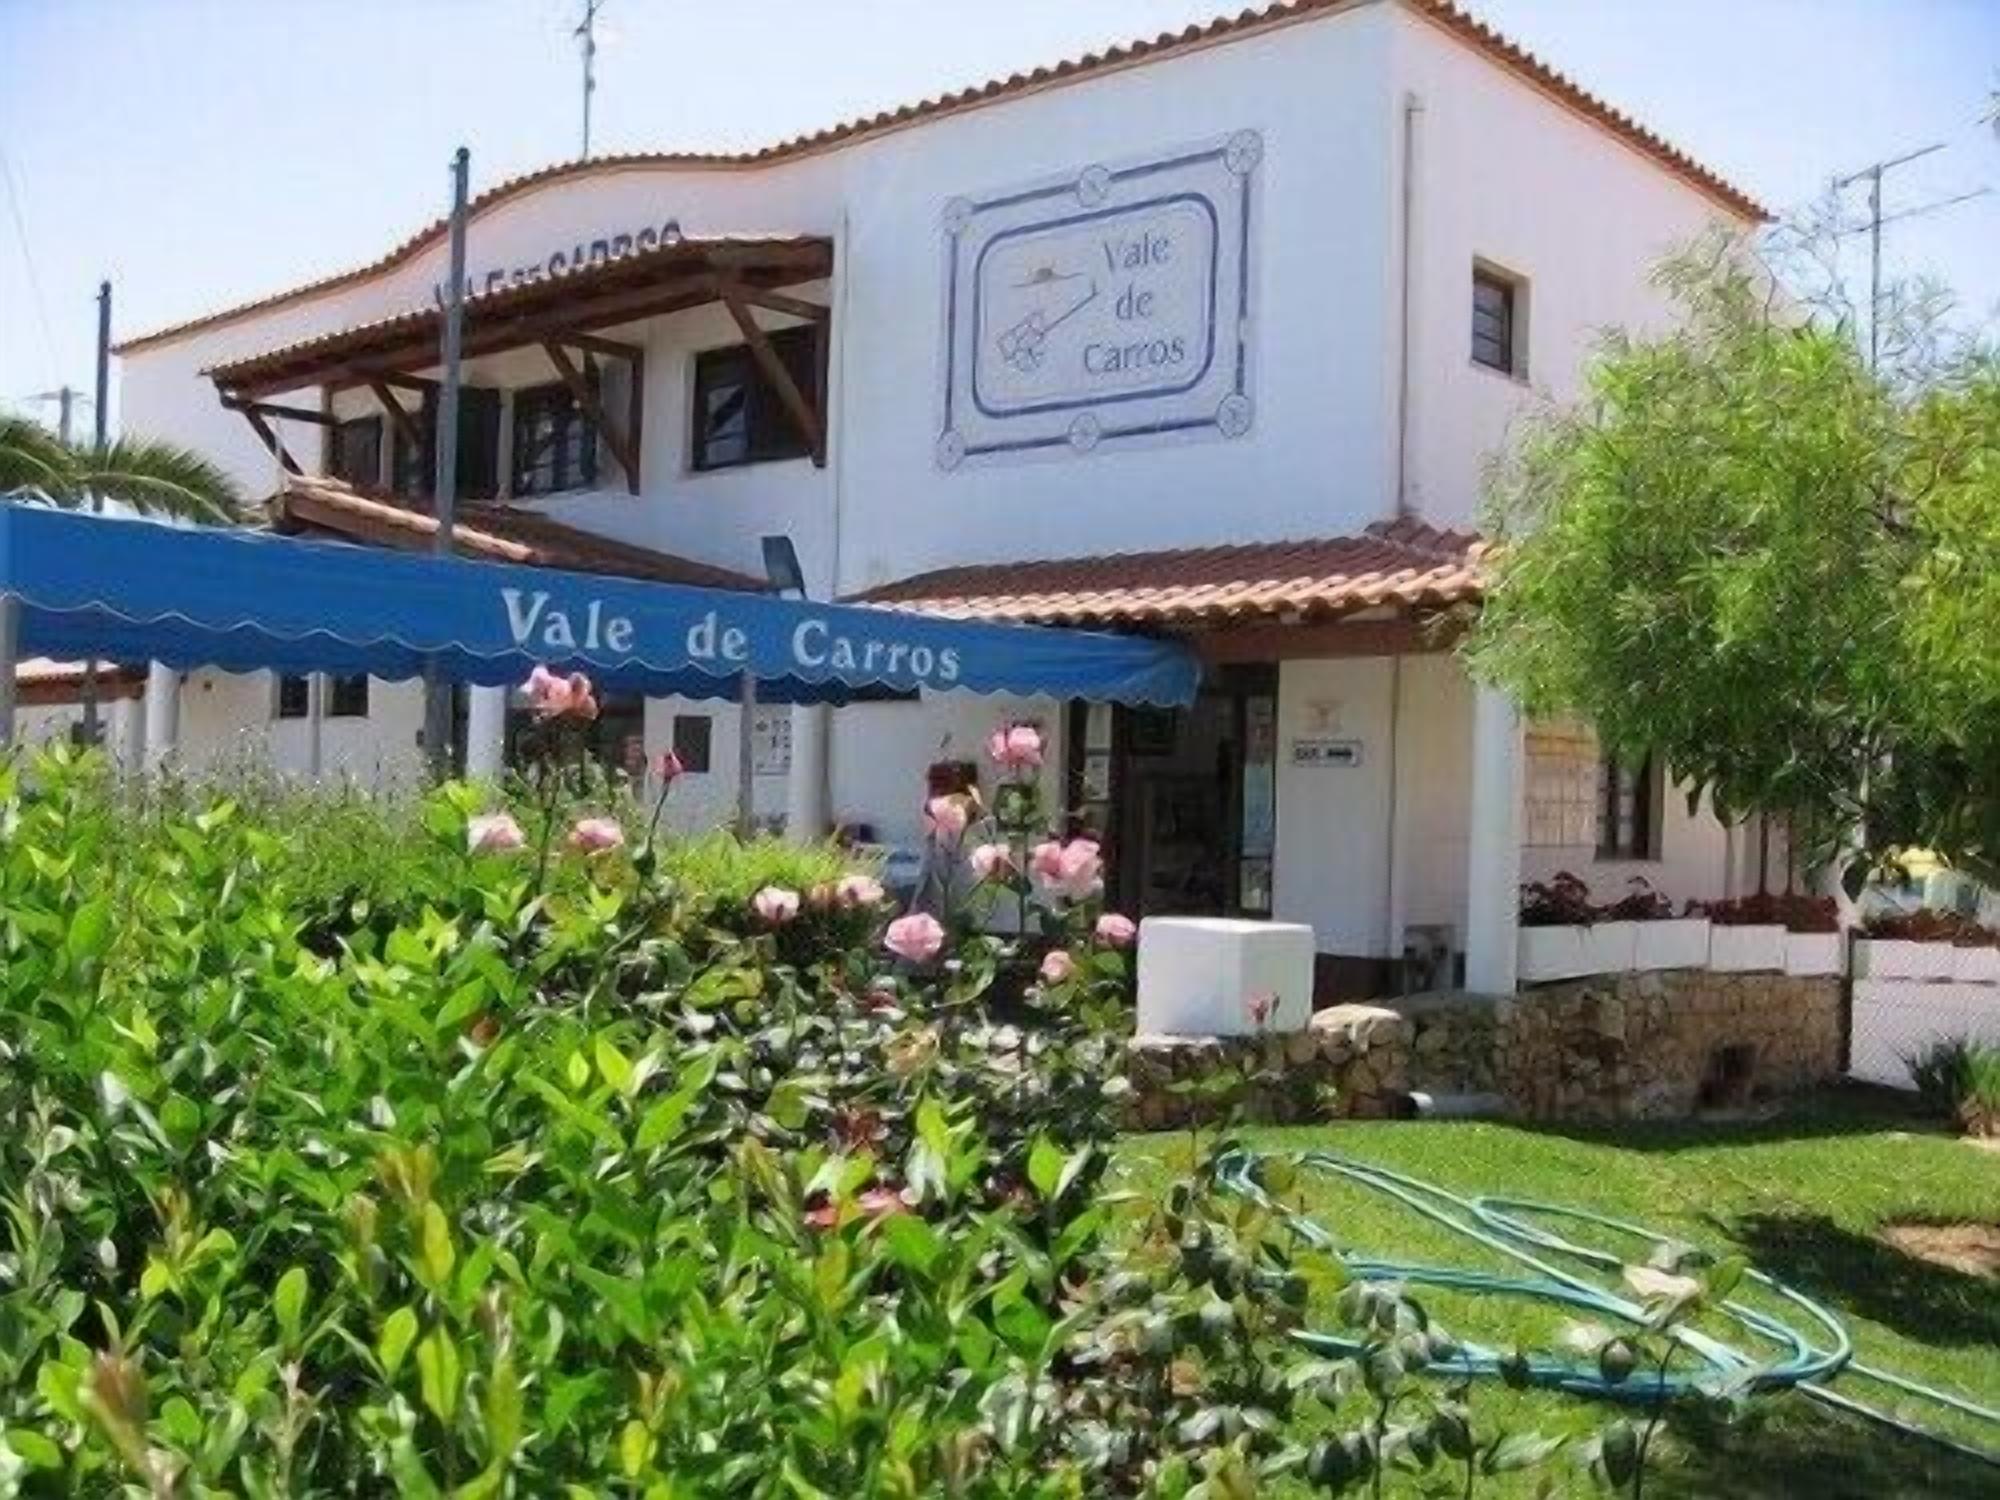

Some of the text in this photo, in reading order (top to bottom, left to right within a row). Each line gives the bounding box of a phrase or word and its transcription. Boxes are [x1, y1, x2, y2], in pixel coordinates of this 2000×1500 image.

[1103, 231, 1169, 273] Vale
[1116, 280, 1153, 320] de
[1084, 337, 1185, 375] Carros
[501, 587, 961, 680] Vale de Carros
